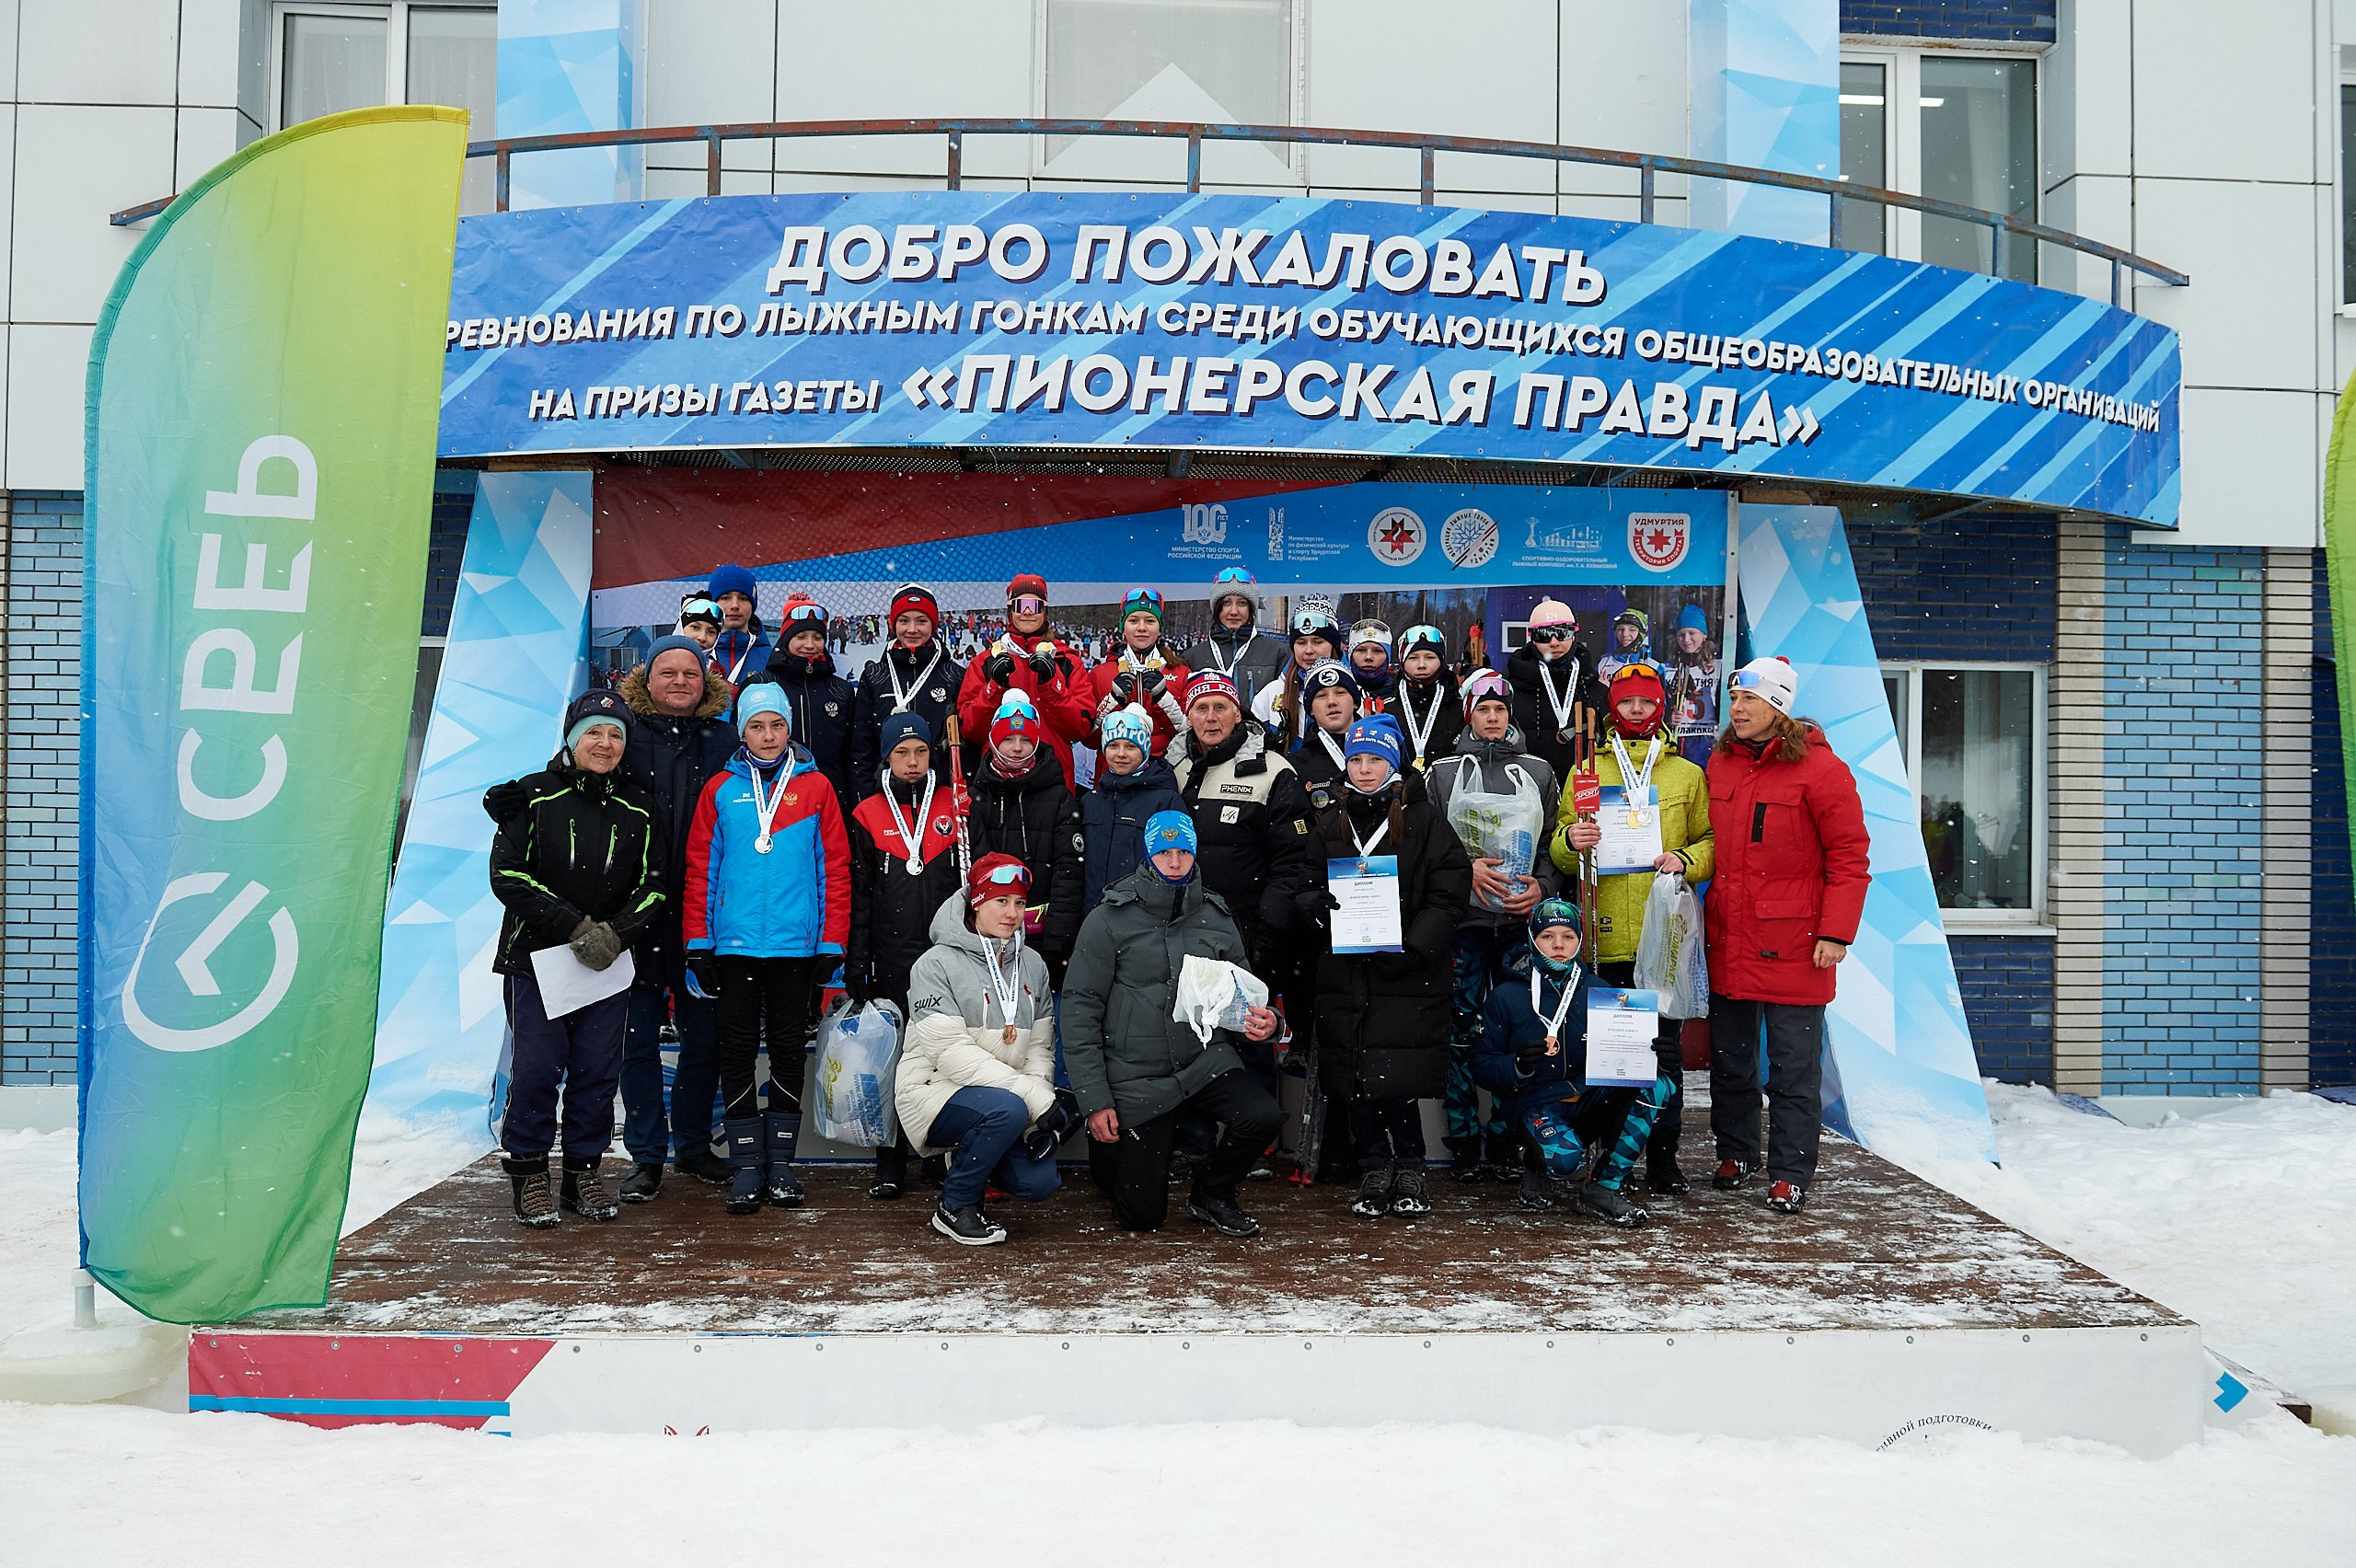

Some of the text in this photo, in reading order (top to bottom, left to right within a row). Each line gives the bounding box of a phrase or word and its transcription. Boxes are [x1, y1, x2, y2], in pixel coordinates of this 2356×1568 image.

[765, 224, 1607, 306] ДОБРО ПОЖАЛОВАТЬ
[684, 304, 745, 338] ПО
[750, 300, 961, 337] ЛЫЖНЫМ
[969, 300, 1147, 335] ГОНКАМ
[1156, 302, 1300, 344] СРЕДИ
[1309, 307, 1628, 360] ОБУЧАЮЩИХСЯ
[1634, 329, 2020, 404] ОБЩЕОБРАЗОВАТЕЛЬНЫХ
[2025, 383, 2161, 433] ОРГАНИЗАЦИЙ
[528, 353, 1822, 452] НА ПРИЗЫ ГАЗЕТЫ «ПИОНЕРСКАЯ ПРАВДА»
[1634, 539, 1683, 564] ТЕРРИТОРИЯ СПОРТА
[1220, 785, 1253, 793] PHENIX
[1576, 789, 1599, 799] SPORT
[1918, 1414, 1992, 1431] ПОДГОТОВКИ
